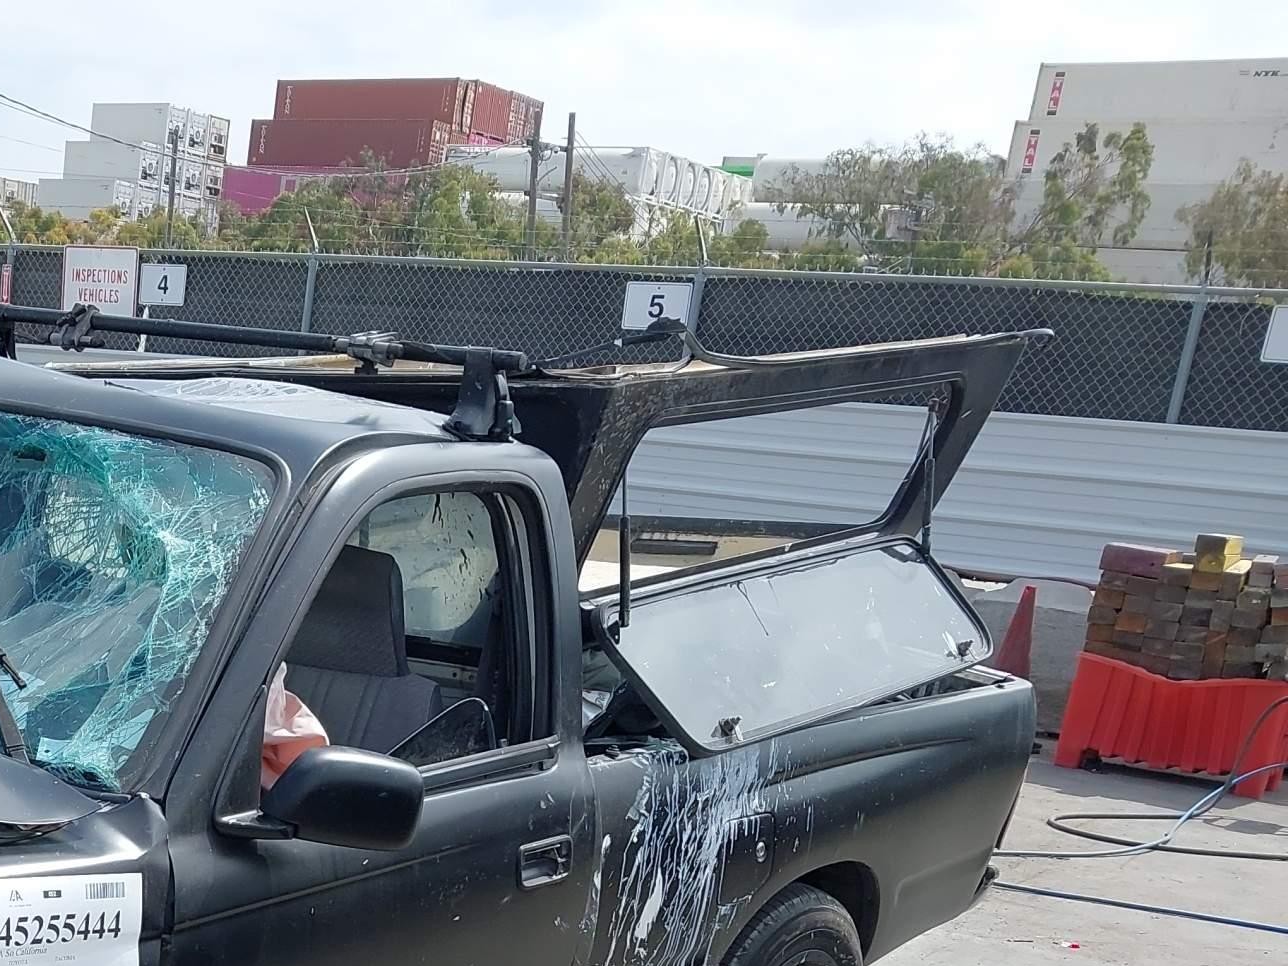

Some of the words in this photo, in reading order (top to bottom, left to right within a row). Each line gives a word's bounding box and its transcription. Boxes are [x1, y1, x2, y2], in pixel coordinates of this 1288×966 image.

[72, 268, 129, 284] INSPECTIONS
[157, 274, 169, 295] 4
[78, 287, 120, 304] VEHICLES
[647, 294, 665, 318] 5
